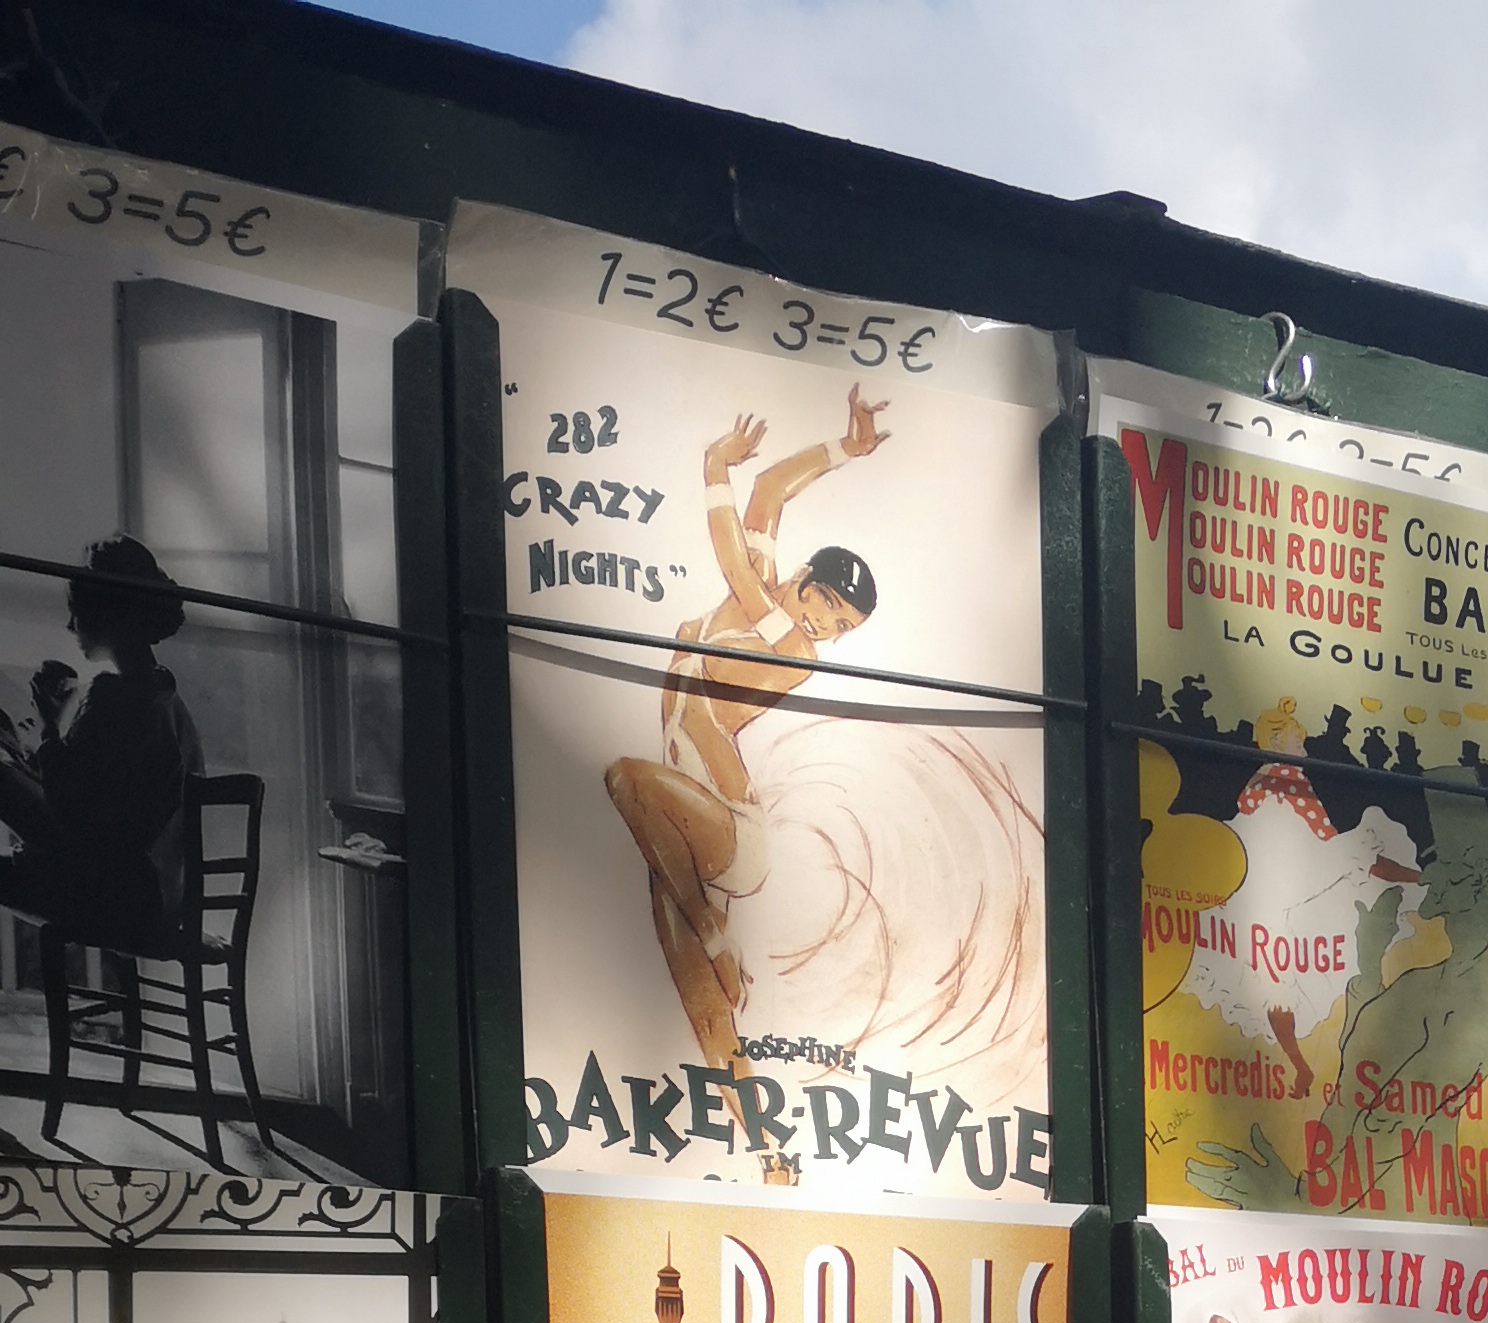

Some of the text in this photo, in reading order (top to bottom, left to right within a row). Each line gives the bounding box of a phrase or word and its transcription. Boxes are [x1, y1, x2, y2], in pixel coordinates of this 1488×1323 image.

[596, 252, 935, 373] 1=2€ 3=5€
[547, 405, 619, 454] 282
[502, 471, 665, 526] CRAZY
[1291, 485, 1389, 543] ROUGE
[1287, 533, 1385, 589] ROUGE
[1286, 578, 1382, 633] ROUGE
[1224, 620, 1473, 689] LA GOULUE
[1406, 631, 1454, 653] TOUS
[1251, 923, 1346, 983] ROUGE
[733, 1034, 857, 1074] JOSEPHINE
[1149, 1038, 1285, 1100] Mercredis
[1304, 1119, 1387, 1211] BAL
[1227, 1255, 1245, 1273] DU
[1257, 1248, 1426, 1311] MOULIN
